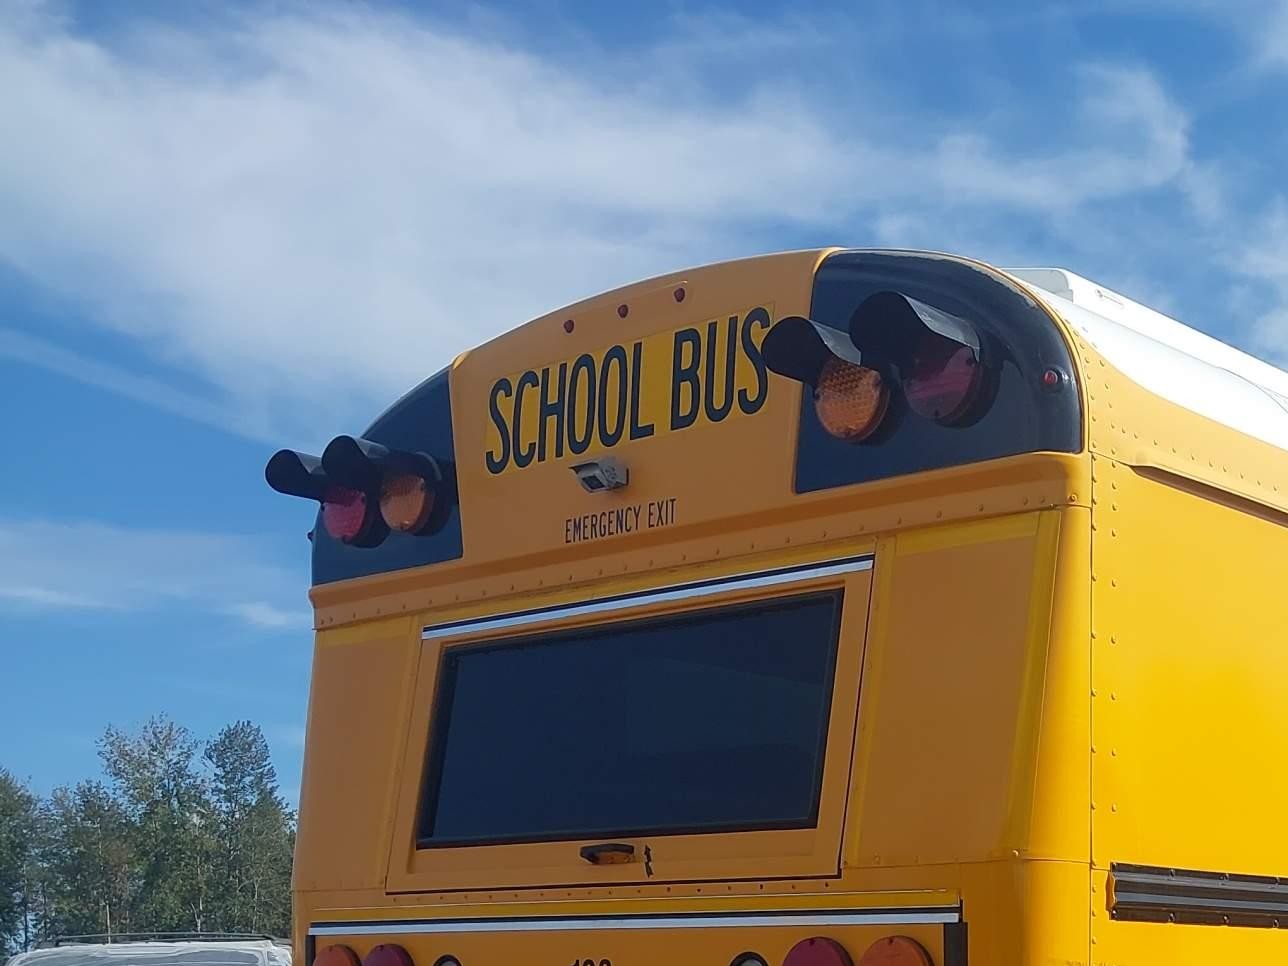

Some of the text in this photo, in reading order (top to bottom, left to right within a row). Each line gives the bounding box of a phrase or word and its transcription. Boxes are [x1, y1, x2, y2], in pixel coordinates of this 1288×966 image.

[485, 306, 771, 475] SCHOOL BUS
[565, 498, 677, 544] EMERGENCY EXIT
